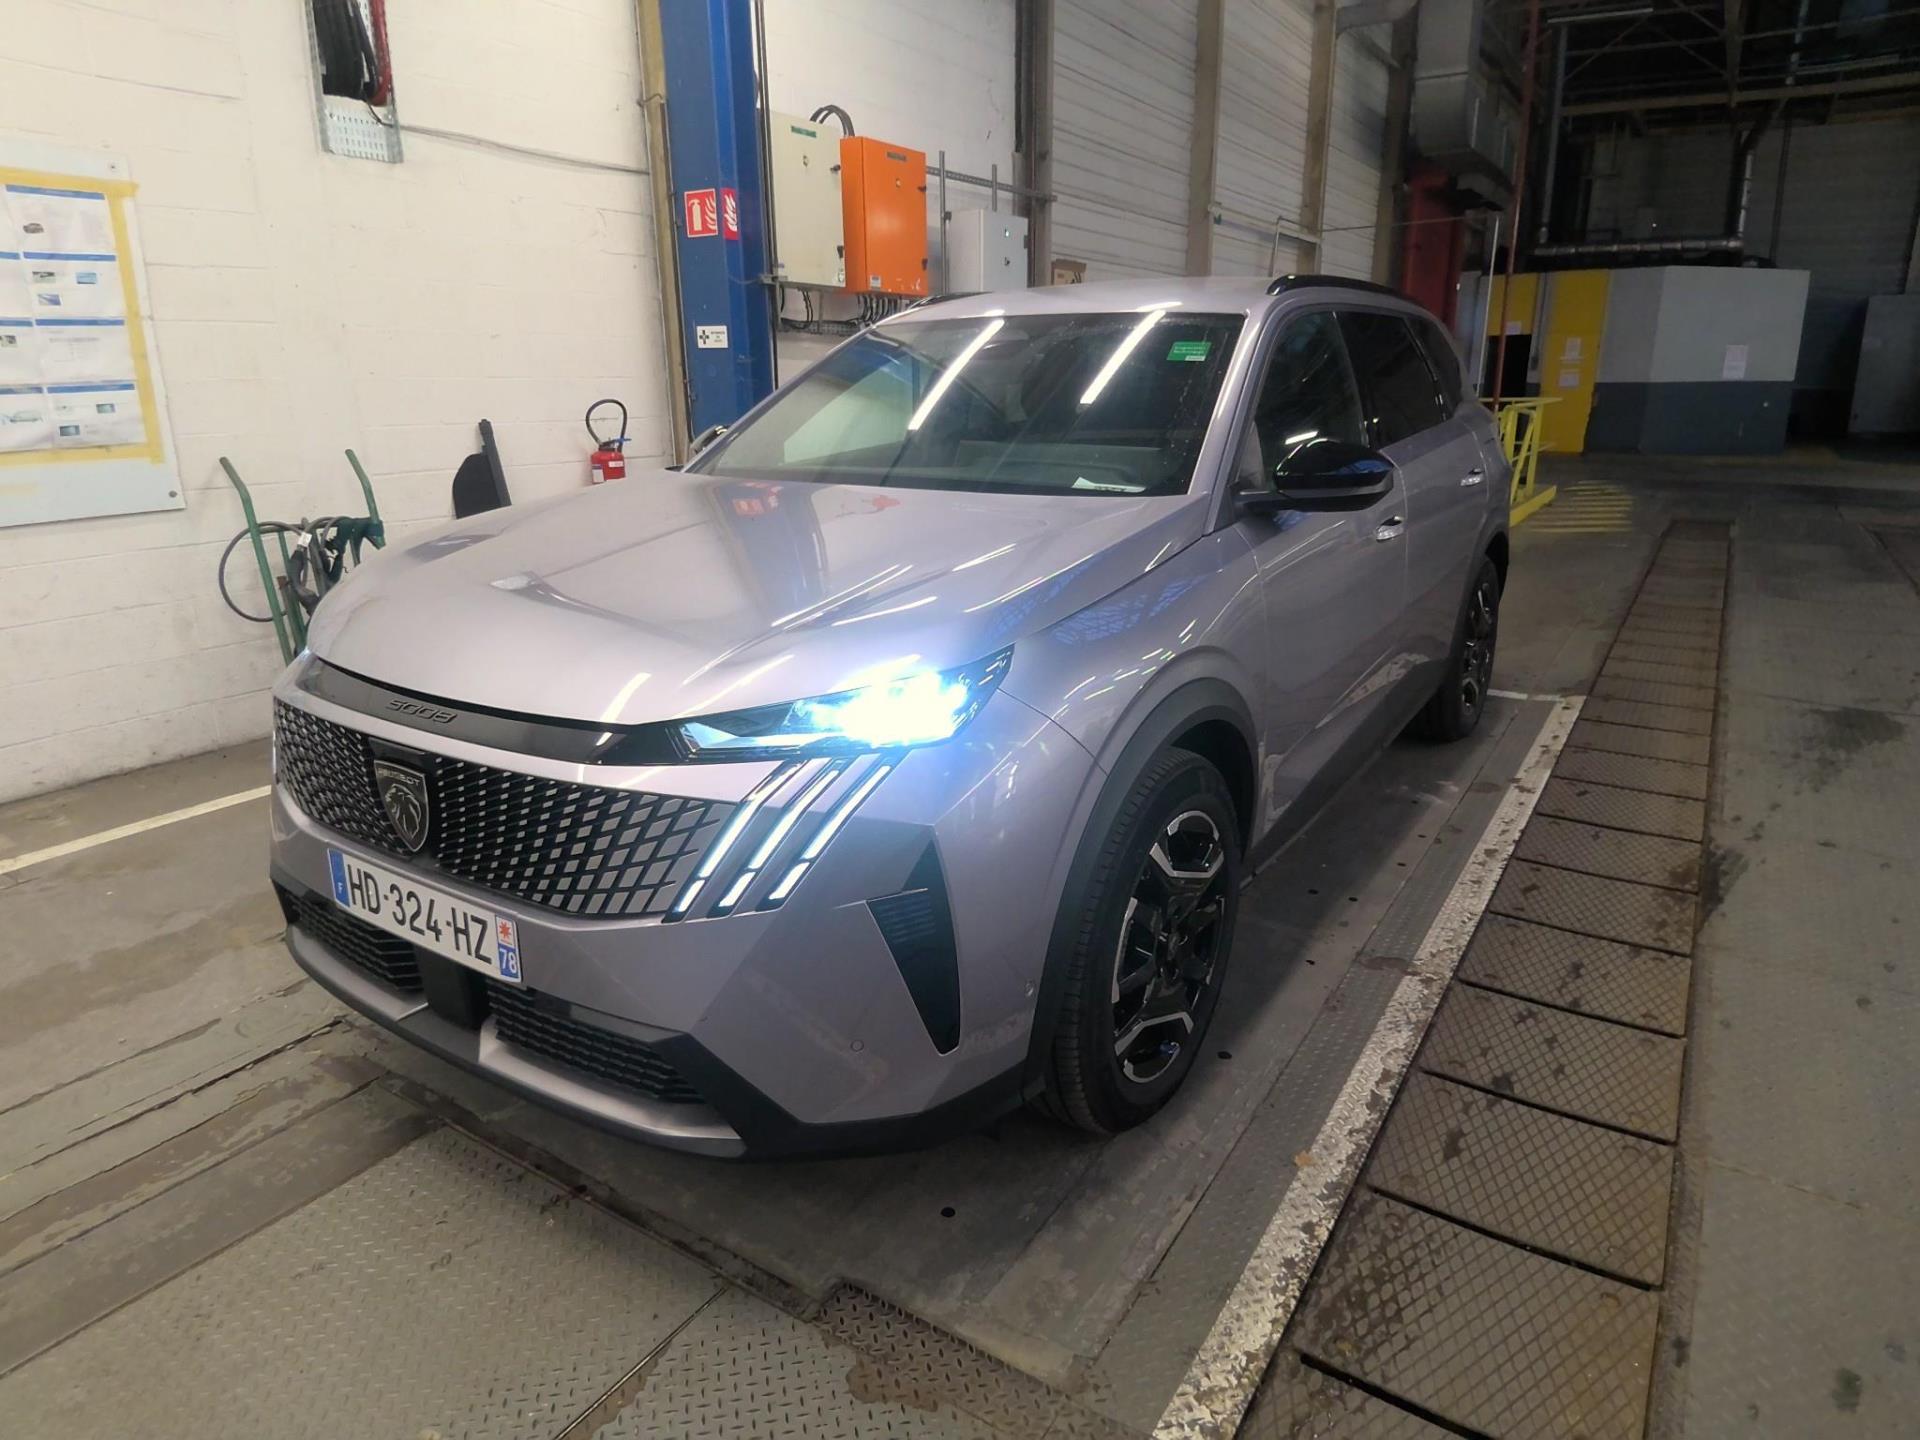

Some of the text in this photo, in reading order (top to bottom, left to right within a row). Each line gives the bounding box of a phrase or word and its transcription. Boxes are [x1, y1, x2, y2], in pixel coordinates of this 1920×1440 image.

[385, 700, 458, 724] 5008
[347, 863, 492, 965] HD-324-HZ
[500, 949, 517, 974] 78
